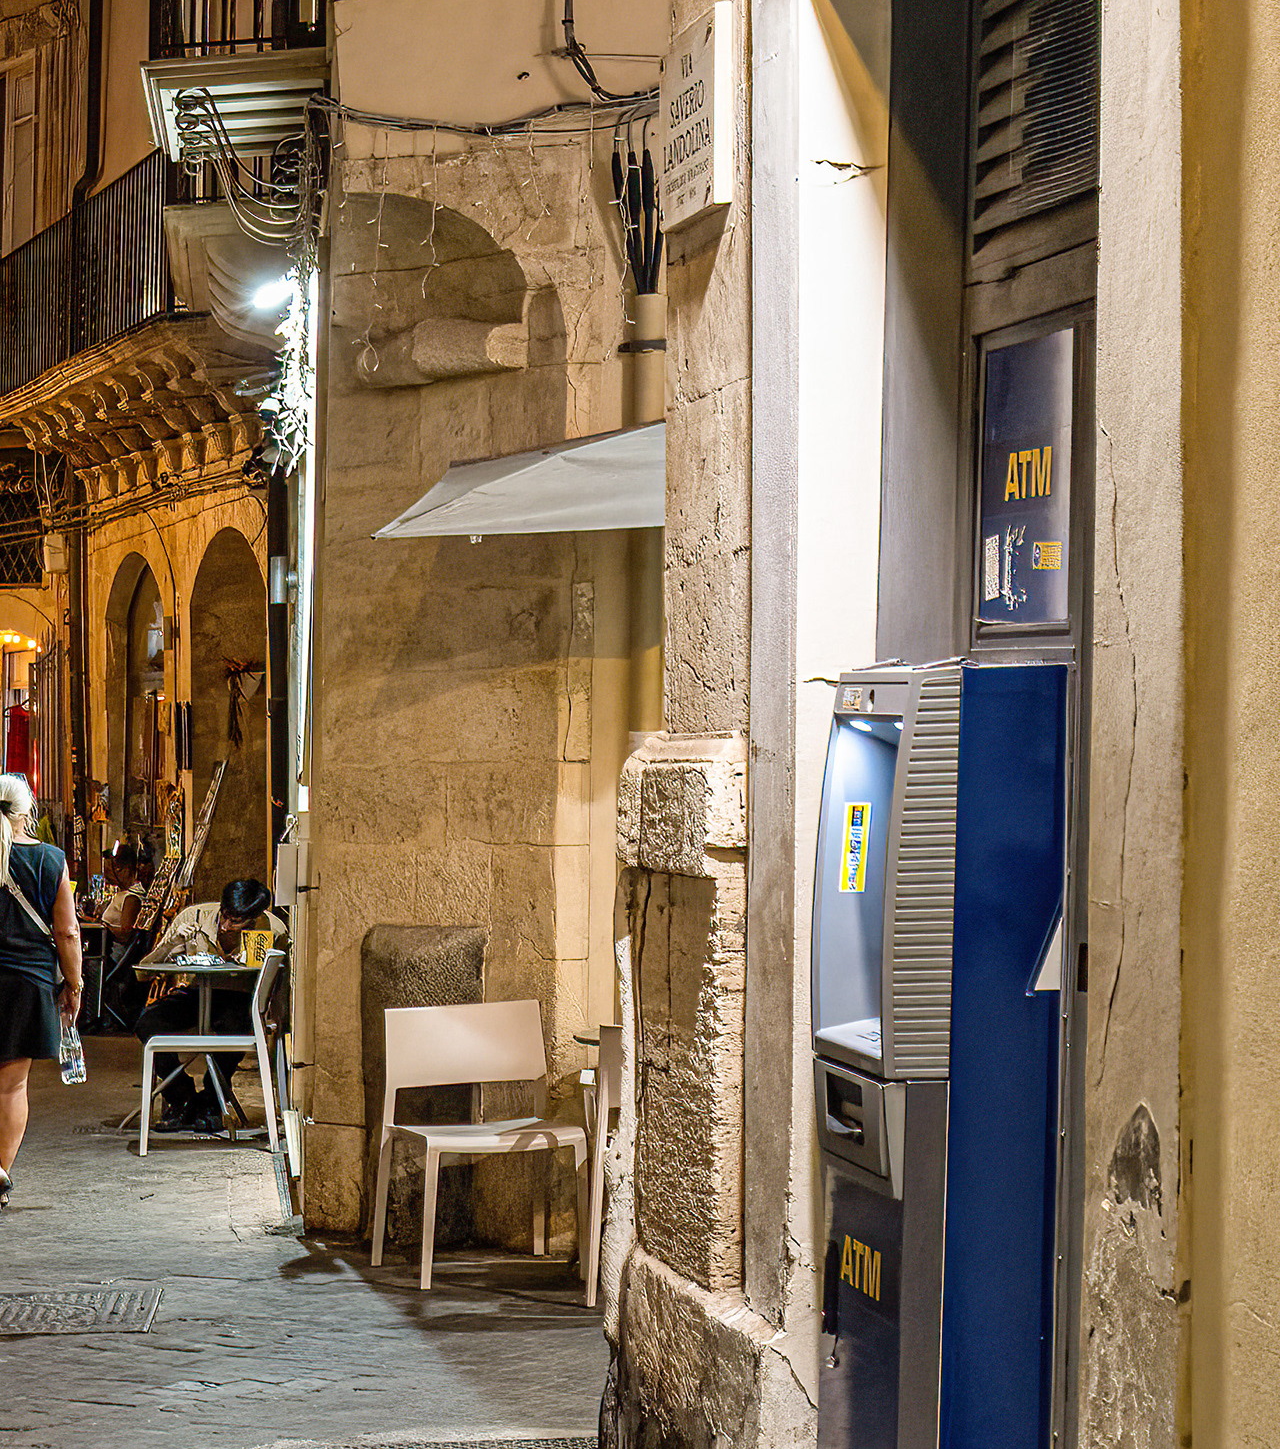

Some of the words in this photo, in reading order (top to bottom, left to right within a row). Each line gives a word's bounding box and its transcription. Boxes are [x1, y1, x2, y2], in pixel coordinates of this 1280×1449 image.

[670, 80, 704, 129] SAVERIO
[663, 117, 712, 174] LANDOLINA
[1005, 446, 1052, 502] ATM
[840, 1234, 881, 1302] ATM
